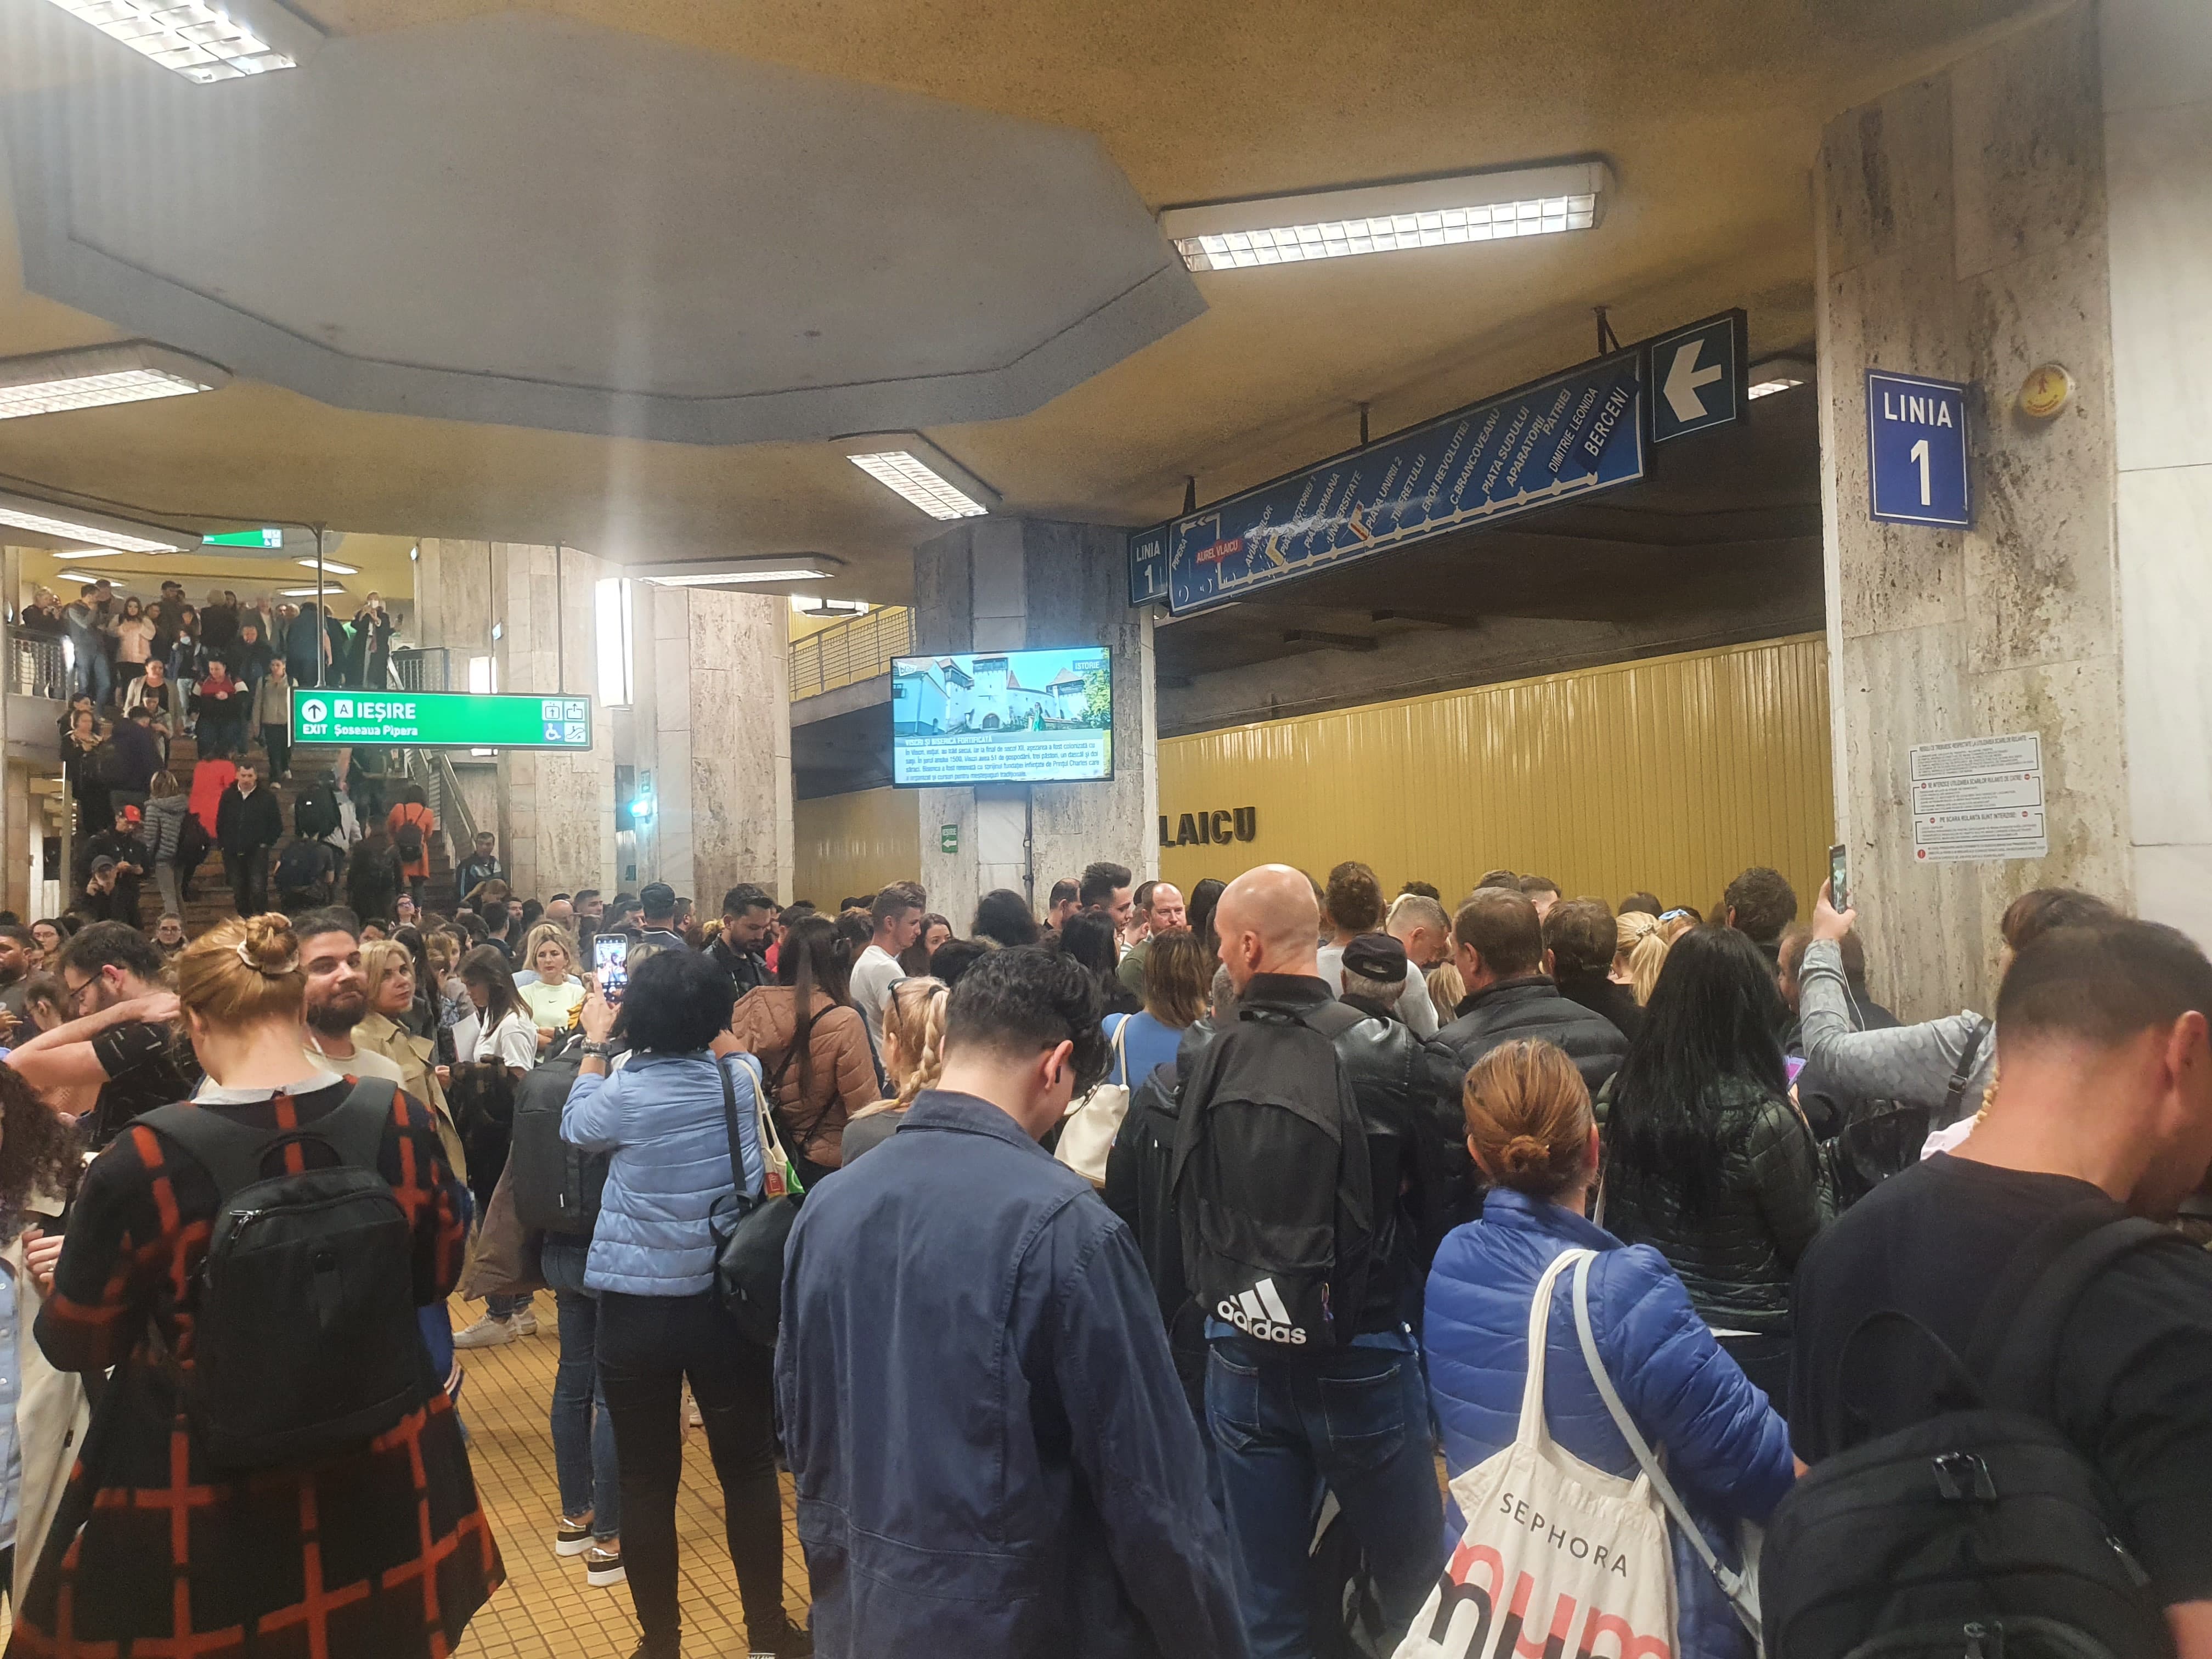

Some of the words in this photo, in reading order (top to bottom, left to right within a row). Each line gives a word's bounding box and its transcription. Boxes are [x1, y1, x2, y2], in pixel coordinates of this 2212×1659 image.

[1542, 388, 1572, 436] PATRIEI
[1584, 386, 1629, 456] BERCENI
[1884, 392, 1953, 428] LINIA
[1548, 430, 1575, 473] DIMITRIE
[1570, 387, 1598, 431] LEONIDA
[1482, 460, 1504, 494] PIATA
[1498, 406, 1530, 460] SUDULUI
[1506, 415, 1545, 487] APARATORII
[1379, 464, 1399, 497] UNIRII
[1910, 439, 1931, 506] 1
[1316, 473, 1340, 520] ROMANA
[1422, 482, 1439, 513] EROII
[1136, 540, 1161, 562] LINIA
[1171, 538, 1188, 571] PIPERA
[1197, 548, 1216, 563] AUREL
[1216, 539, 1239, 556] VLAICU
[1144, 564, 1154, 594] 1
[1075, 661, 1100, 671] ISTORIE
[340, 704, 349, 714] A
[302, 724, 328, 735] EXIT
[382, 724, 418, 738] Pipera
[1159, 806, 1256, 847] LAICU
[1217, 1298, 1307, 1344] adidas
[1499, 1492, 1627, 1577] SEPHORA
